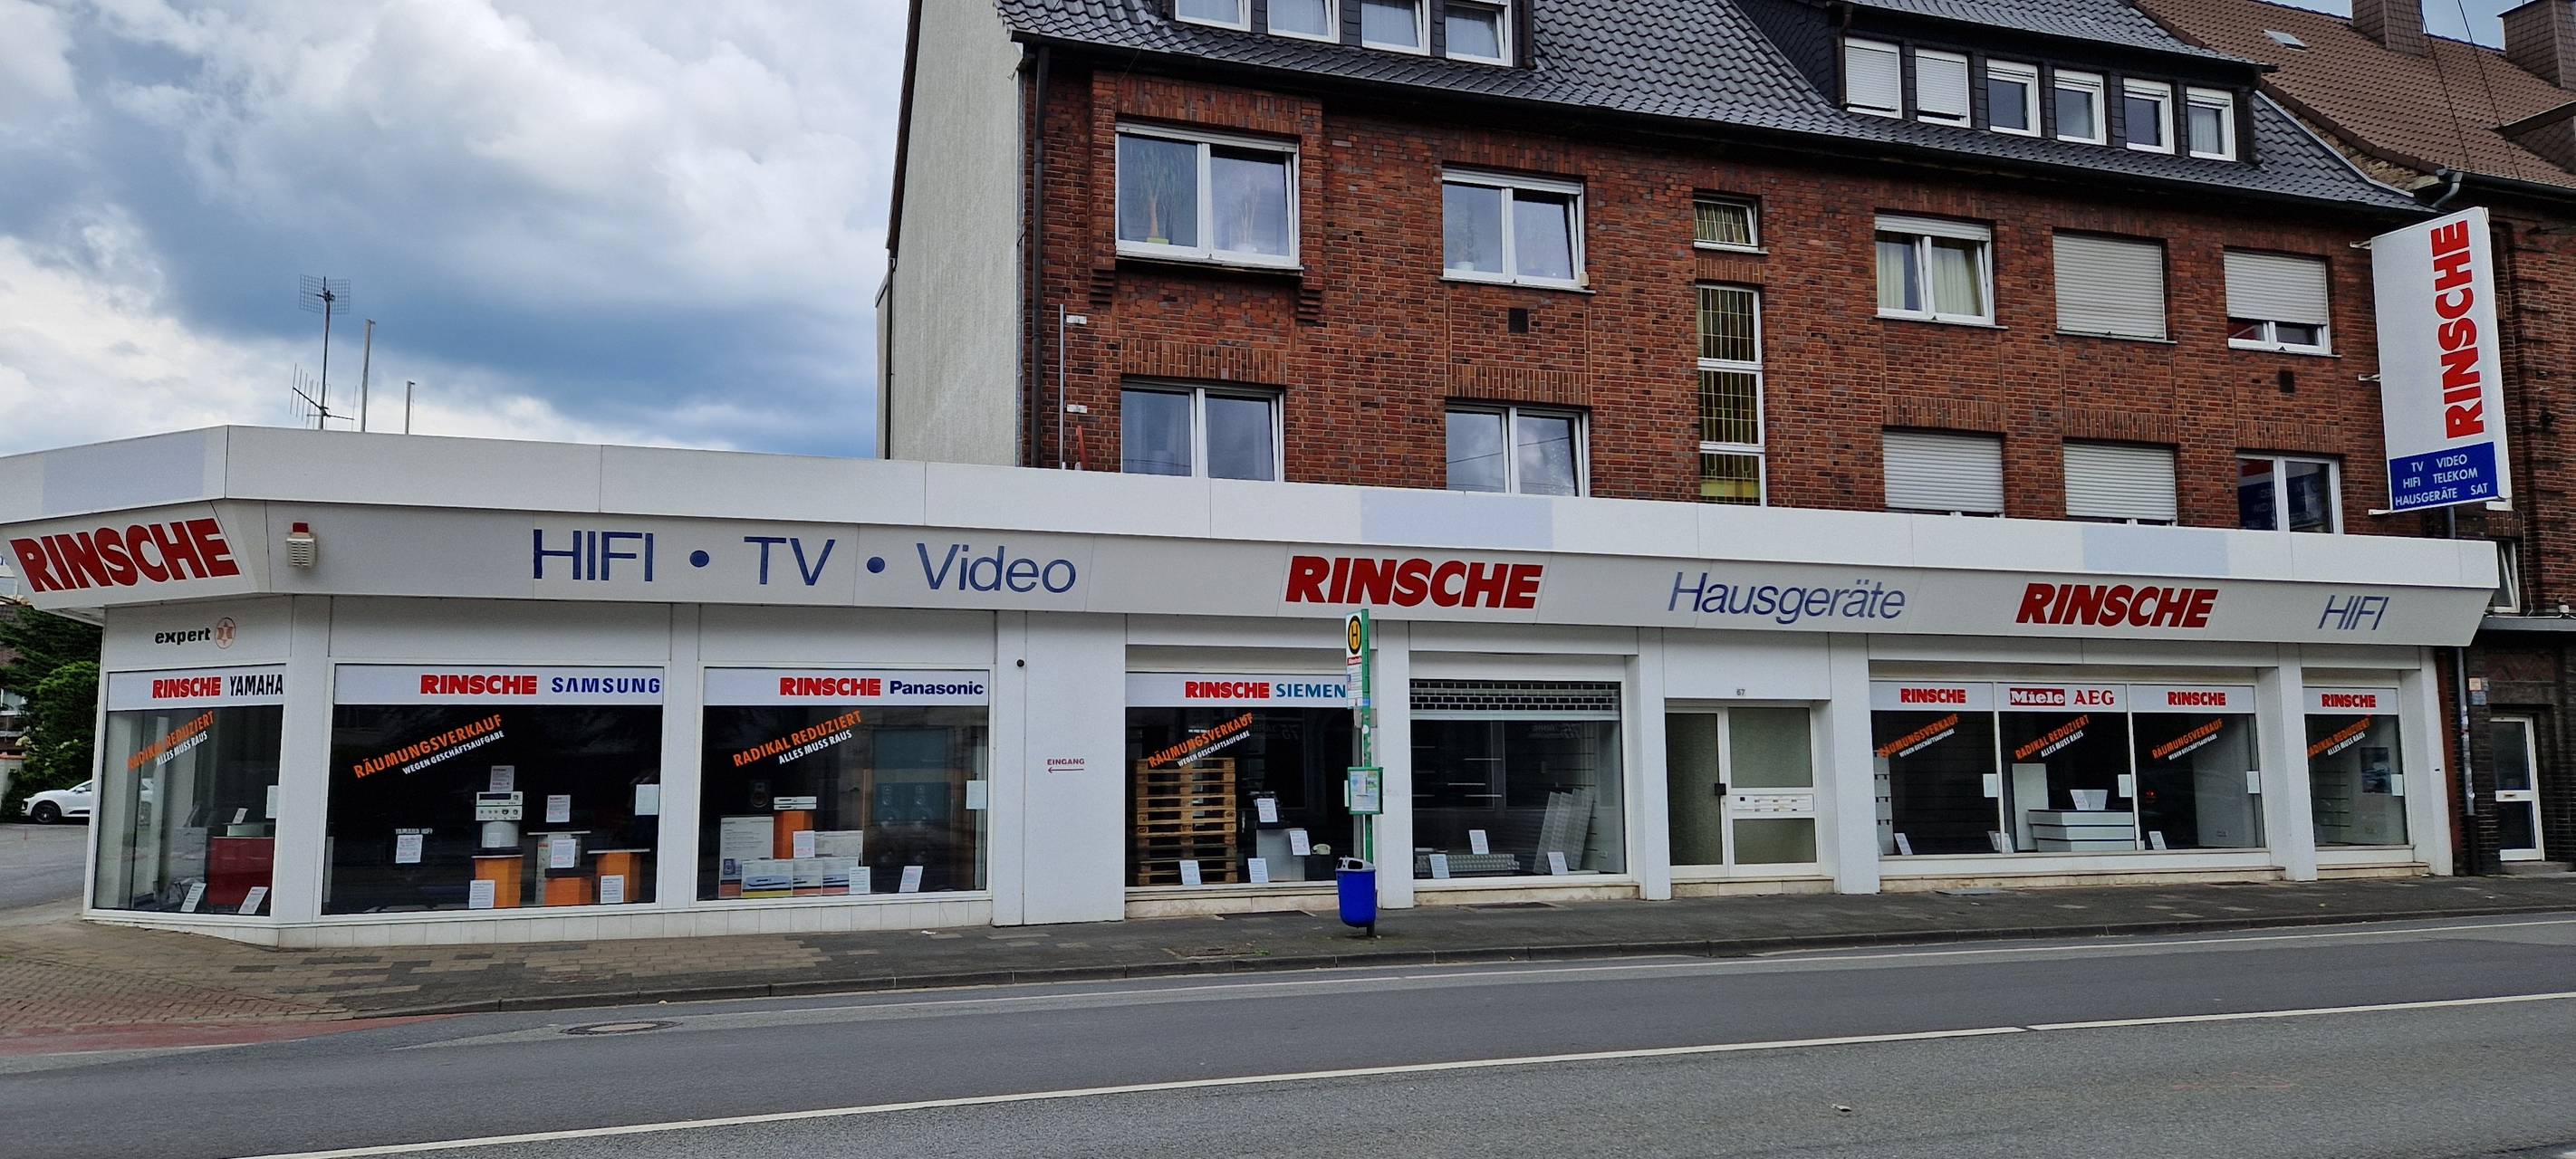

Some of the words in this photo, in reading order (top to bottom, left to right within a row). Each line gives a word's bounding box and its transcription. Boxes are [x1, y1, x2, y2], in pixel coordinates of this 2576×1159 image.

[2431, 220, 2485, 439] RINSCHE
[2403, 476, 2420, 488] HIFI
[2433, 467, 2478, 484] TELEKOM
[2411, 461, 2424, 472] TV
[2436, 454, 2467, 468] VIDEO
[2395, 486, 2457, 506] HAUSGERÄTE
[2470, 483, 2488, 495] SAT
[10, 518, 240, 593] RINSCHE
[533, 529, 653, 582] HIFI
[744, 536, 836, 586] TV
[916, 543, 1076, 593] Video
[1285, 556, 1543, 608] RINSCHE
[1668, 571, 1906, 625] Hausgeräte
[2015, 582, 2219, 628] RINSCHE
[2318, 594, 2389, 631] HIFI
[155, 627, 211, 645] expert
[152, 677, 221, 699] RINSCHE
[229, 675, 284, 696] YAMAHA
[420, 675, 538, 694] RINSCHE
[551, 677, 660, 694] SAMSUNG
[779, 677, 881, 696] RINSCHE
[889, 680, 984, 695] Panasonic
[1185, 682, 1270, 699] RINSCHE
[1276, 684, 1347, 698] SIEMEN
[1900, 688, 1966, 704] RINSCHE
[2011, 690, 2065, 705] Miele
[2073, 690, 2114, 705] AEG
[2167, 691, 2226, 706] RINSCHE
[2321, 694, 2377, 708] RINSCHE
[156, 750, 174, 766] ALLES
[191, 730, 208, 747] RAUS
[166, 711, 214, 750] REDUZIERT
[353, 714, 502, 779] RÄUMUNGSVERKAUF
[733, 737, 791, 767] RADIKAL
[791, 710, 861, 745] REDUZIERT
[779, 748, 803, 765] ALLES
[804, 738, 829, 755] MUSS
[829, 730, 852, 745] RAUS
[1148, 712, 1254, 768] RÄUMUNGSVERKAUF
[1197, 730, 1250, 758] GESCHÄFTSAUFGABE
[2015, 736, 2049, 760] RADIKAL
[2048, 714, 2090, 742] REDUZIERT
[2152, 718, 2224, 759] RÄUMUNGSVERKAUF
[402, 759, 431, 775] WEGEN
[430, 730, 505, 763] GESCHÄFTSAUFGABE
[2041, 744, 2056, 758] ALLES
